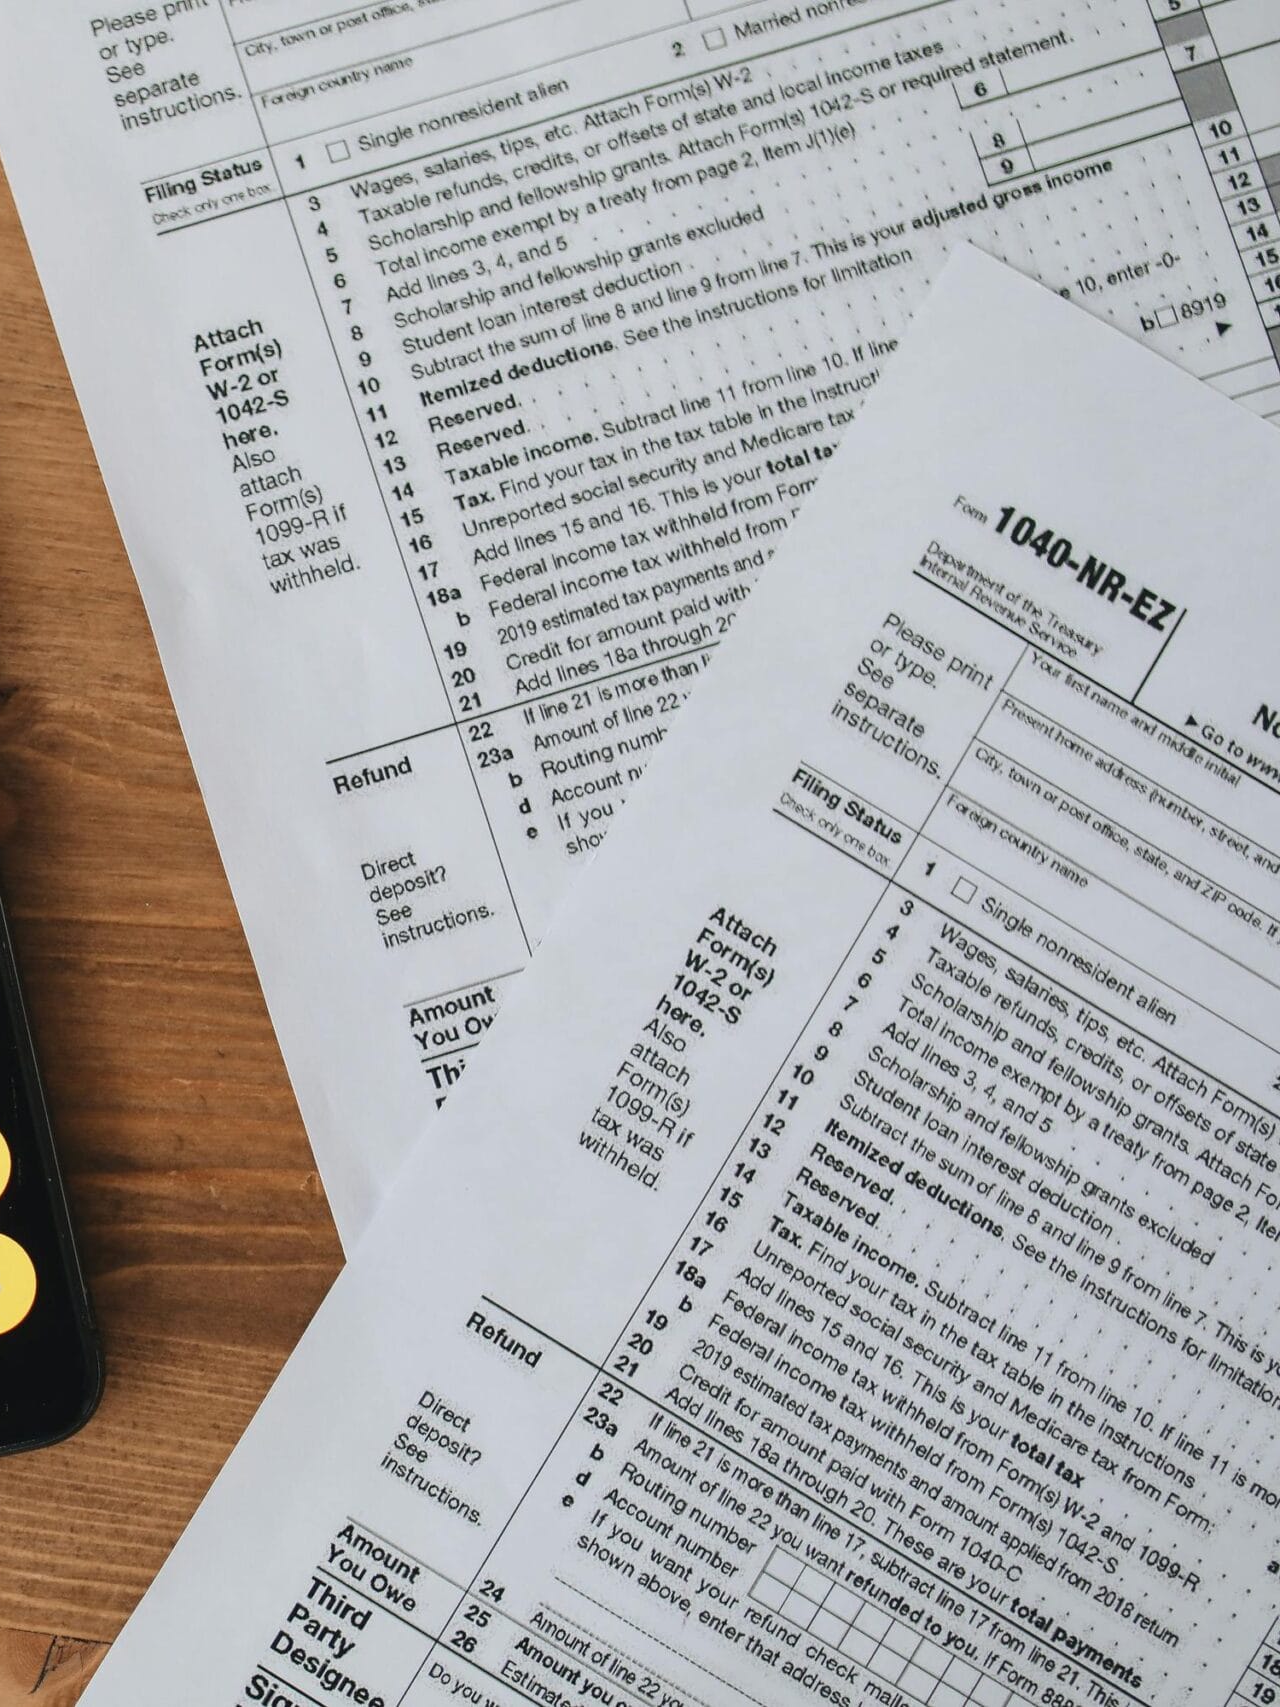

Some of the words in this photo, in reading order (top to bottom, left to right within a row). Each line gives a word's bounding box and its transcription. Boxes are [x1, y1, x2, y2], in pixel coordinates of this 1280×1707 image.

[88, 8, 158, 38] Please
[97, 43, 119, 61] or
[123, 29, 174, 57] type.
[104, 61, 146, 84] See
[112, 71, 200, 108] separate
[118, 86, 243, 131] instructions.
[293, 152, 306, 170] 1
[356, 124, 415, 152] Single
[416, 90, 524, 135] nonresident
[525, 78, 570, 103] alien
[307, 194, 322, 212] 3
[348, 171, 419, 199] Wages,
[422, 148, 497, 179] salaries,
[498, 135, 540, 157] tips,
[543, 123, 578, 143] etc.
[582, 100, 641, 131] Attach
[642, 78, 712, 112] Form(s)
[711, 65, 753, 91] W-2
[142, 177, 198, 204] Filing
[199, 158, 263, 187] Status
[1179, 290, 1227, 320] 8919
[192, 317, 265, 354] Attach
[197, 337, 283, 378] Form(s)
[364, 402, 388, 424] 11
[417, 367, 504, 408] Itemized
[506, 338, 619, 381] deductions.
[622, 324, 659, 346] See
[660, 314, 693, 334] the
[693, 282, 800, 325] instructions
[801, 273, 827, 292] for
[829, 248, 913, 284] limitation
[203, 372, 253, 401] W-2
[255, 367, 279, 386] or
[214, 387, 290, 425] 1042-S
[220, 423, 279, 451] here.
[231, 448, 276, 474] Also
[238, 464, 303, 498] attach
[243, 483, 324, 523] Form(s)
[254, 507, 331, 546] 1099-R
[330, 501, 347, 524] if
[260, 548, 296, 571] tax
[297, 535, 341, 559] was
[268, 551, 361, 595] withheld.
[951, 493, 988, 525] Form
[993, 504, 1177, 630] 1040-NR-EZ
[917, 552, 970, 592] Internal
[967, 583, 1027, 627] Revenue
[1027, 619, 1078, 658] Service
[925, 539, 1006, 596] Department
[1004, 590, 1022, 605] of
[1020, 597, 1043, 620] the
[1046, 610, 1104, 658] Treasury
[856, 656, 895, 690] See
[869, 637, 893, 658] or
[892, 648, 937, 689] type.
[881, 611, 946, 662] Please
[945, 654, 994, 691] print
[466, 719, 495, 743] 22
[521, 705, 536, 727] If
[536, 700, 569, 722] line
[569, 689, 592, 711] 21
[595, 685, 613, 703] is
[613, 672, 659, 699] more
[659, 660, 700, 684] than
[842, 680, 926, 739] separate
[1030, 649, 1062, 679] Your
[1063, 671, 1092, 697] first
[1088, 690, 1129, 720] name
[1128, 714, 1158, 737] and
[1156, 730, 1204, 765] middle
[1202, 758, 1242, 789] initial
[829, 697, 941, 780] instructions.
[331, 754, 413, 796] Refund
[778, 791, 814, 822] Check
[816, 817, 843, 838] only
[842, 832, 866, 852] one
[790, 766, 843, 811] Filing
[842, 798, 903, 845] Status
[973, 745, 1003, 775] City,
[1006, 765, 1042, 796] town
[1041, 789, 1059, 805] or
[1056, 798, 1092, 825] post
[1090, 819, 1129, 853] office,
[1132, 844, 1170, 876] state,
[1171, 868, 1202, 892] and
[1198, 881, 1228, 904] ZIP
[359, 850, 417, 882] Direct
[945, 791, 999, 834] Foreign
[997, 827, 1050, 866] country
[1048, 857, 1089, 889] name
[368, 864, 447, 904] deposit?
[374, 903, 413, 927] See
[380, 904, 495, 950] instructions.
[980, 894, 1034, 939] Single
[1034, 931, 1136, 1001] nonresident
[1134, 993, 1177, 1026] alien
[408, 984, 496, 1029] Amount
[884, 923, 901, 942] 4
[925, 944, 992, 998] Taxable
[992, 991, 1059, 1045] refunds,
[1063, 1036, 1124, 1085] credits,
[1130, 1076, 1153, 1095] or
[1152, 1089, 1212, 1133] offsets
[1212, 1126, 1237, 1145] of
[1233, 1138, 1277, 1173] state
[464, 1309, 544, 1369] Refund
[404, 1413, 483, 1467] deposit?
[673, 1258, 707, 1290] 18a
[720, 1287, 789, 1338] Federal
[786, 1327, 849, 1377] income
[850, 1367, 879, 1397] tax
[880, 1387, 956, 1441] withheld
[952, 1430, 995, 1467] from
[994, 1455, 1062, 1510] Form(s)
[1061, 1494, 1101, 1531] W-2
[1099, 1524, 1137, 1554] and
[1138, 1544, 1201, 1594] 1099-R
[601, 1486, 674, 1540] Account
[673, 1532, 740, 1579] number
[618, 1460, 689, 1516] Routing
[686, 1505, 758, 1555] number
[326, 1541, 368, 1582] You
[368, 1572, 417, 1613] Owe
[334, 1522, 421, 1585] Amount
[285, 1600, 357, 1660] Party
[305, 1574, 374, 1632] Third
[268, 1628, 385, 1707] Designee
